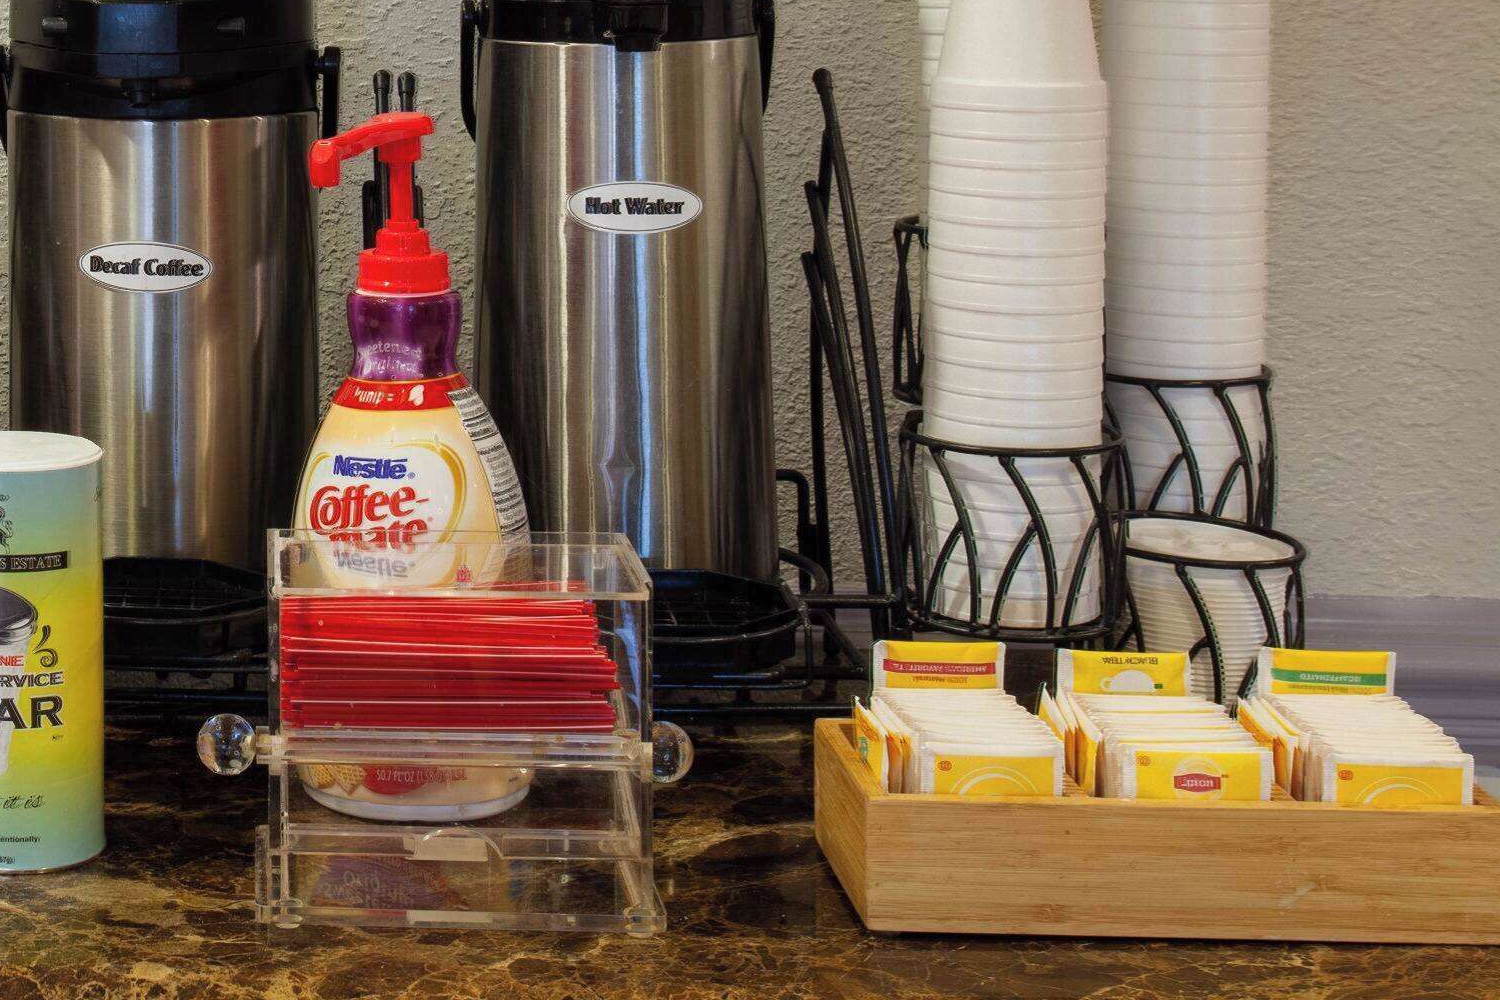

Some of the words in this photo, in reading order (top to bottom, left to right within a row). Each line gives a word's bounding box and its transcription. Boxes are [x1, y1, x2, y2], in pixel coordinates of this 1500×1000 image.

[585, 196, 621, 216] Hot
[624, 197, 685, 216] Water
[89, 255, 141, 275] Decaf
[143, 258, 205, 277] Coffee
[10, 554, 63, 570] ESTATE
[2, 794, 20, 810] it
[23, 794, 45, 809] is
